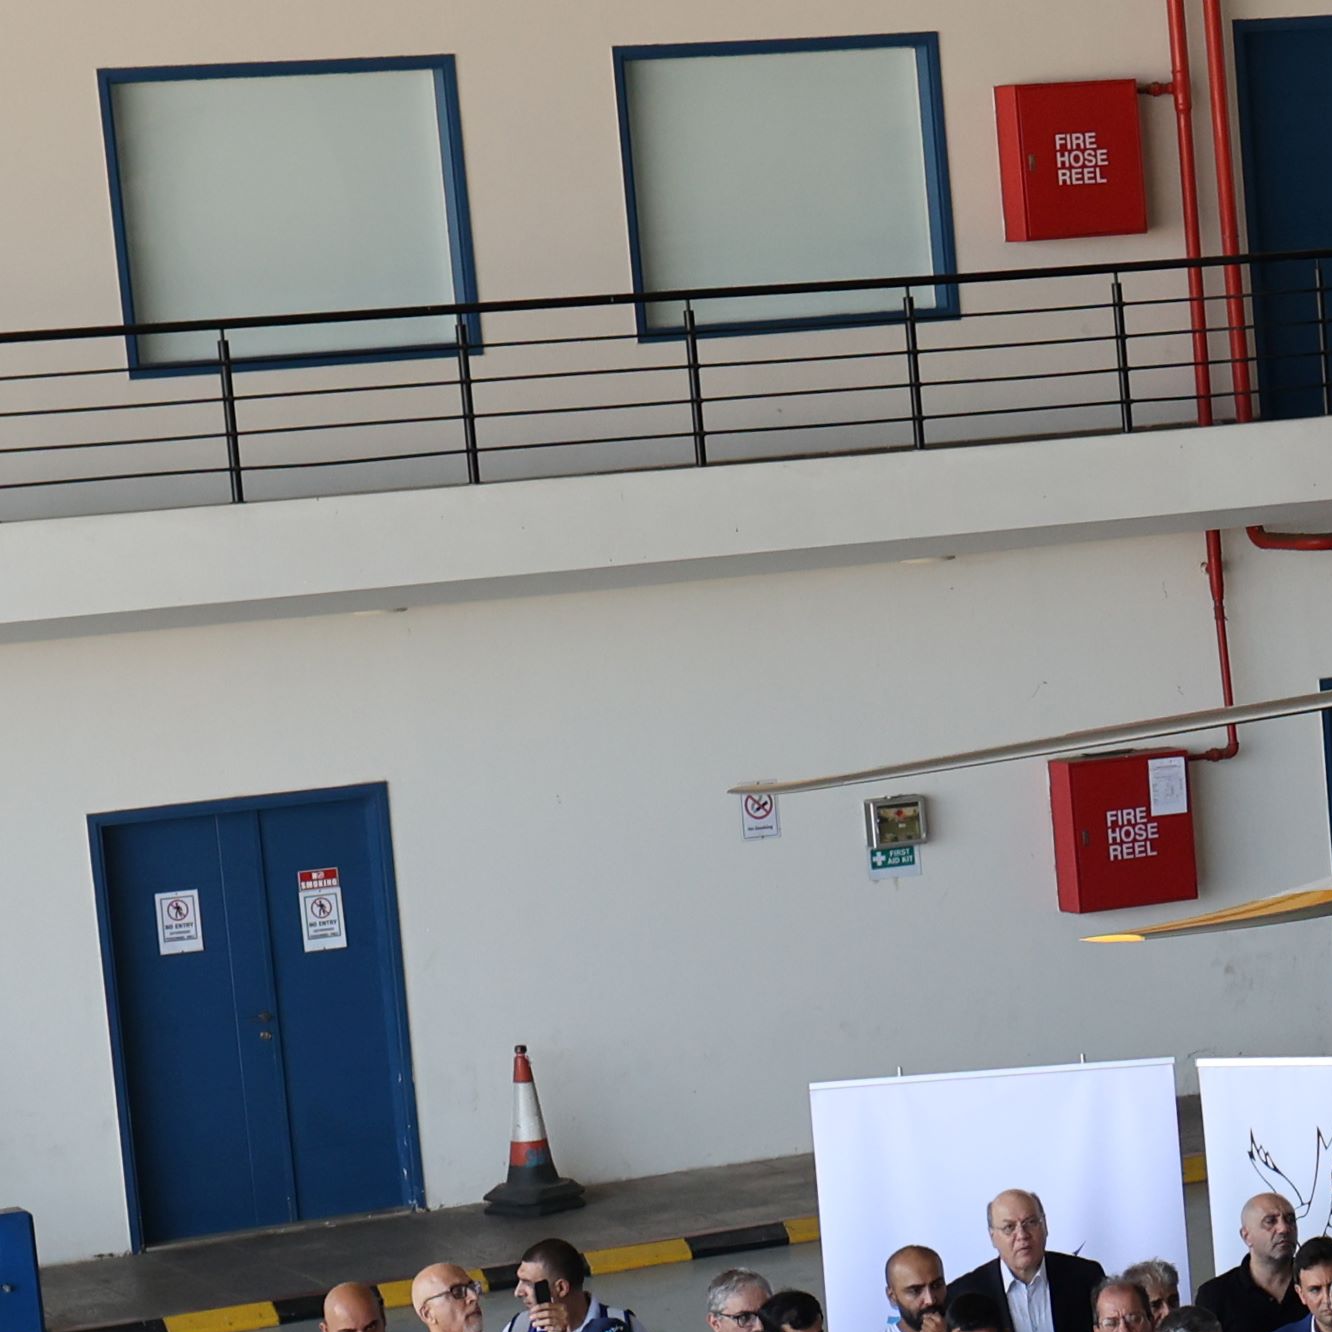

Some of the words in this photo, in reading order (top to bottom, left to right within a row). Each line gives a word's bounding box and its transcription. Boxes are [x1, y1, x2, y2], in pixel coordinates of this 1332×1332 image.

[1055, 132, 1097, 150] FIRE
[1056, 149, 1109, 168] HOSE
[1057, 167, 1107, 186] REEL
[1106, 807, 1147, 827] FIRE
[1107, 822, 1159, 844] HOSE
[887, 857, 900, 865] AID
[901, 855, 913, 864] KIT
[889, 848, 911, 857] FIRST
[1109, 841, 1157, 861] REEL
[301, 879, 337, 889] SMOKING
[318, 919, 337, 927] ENTRY
